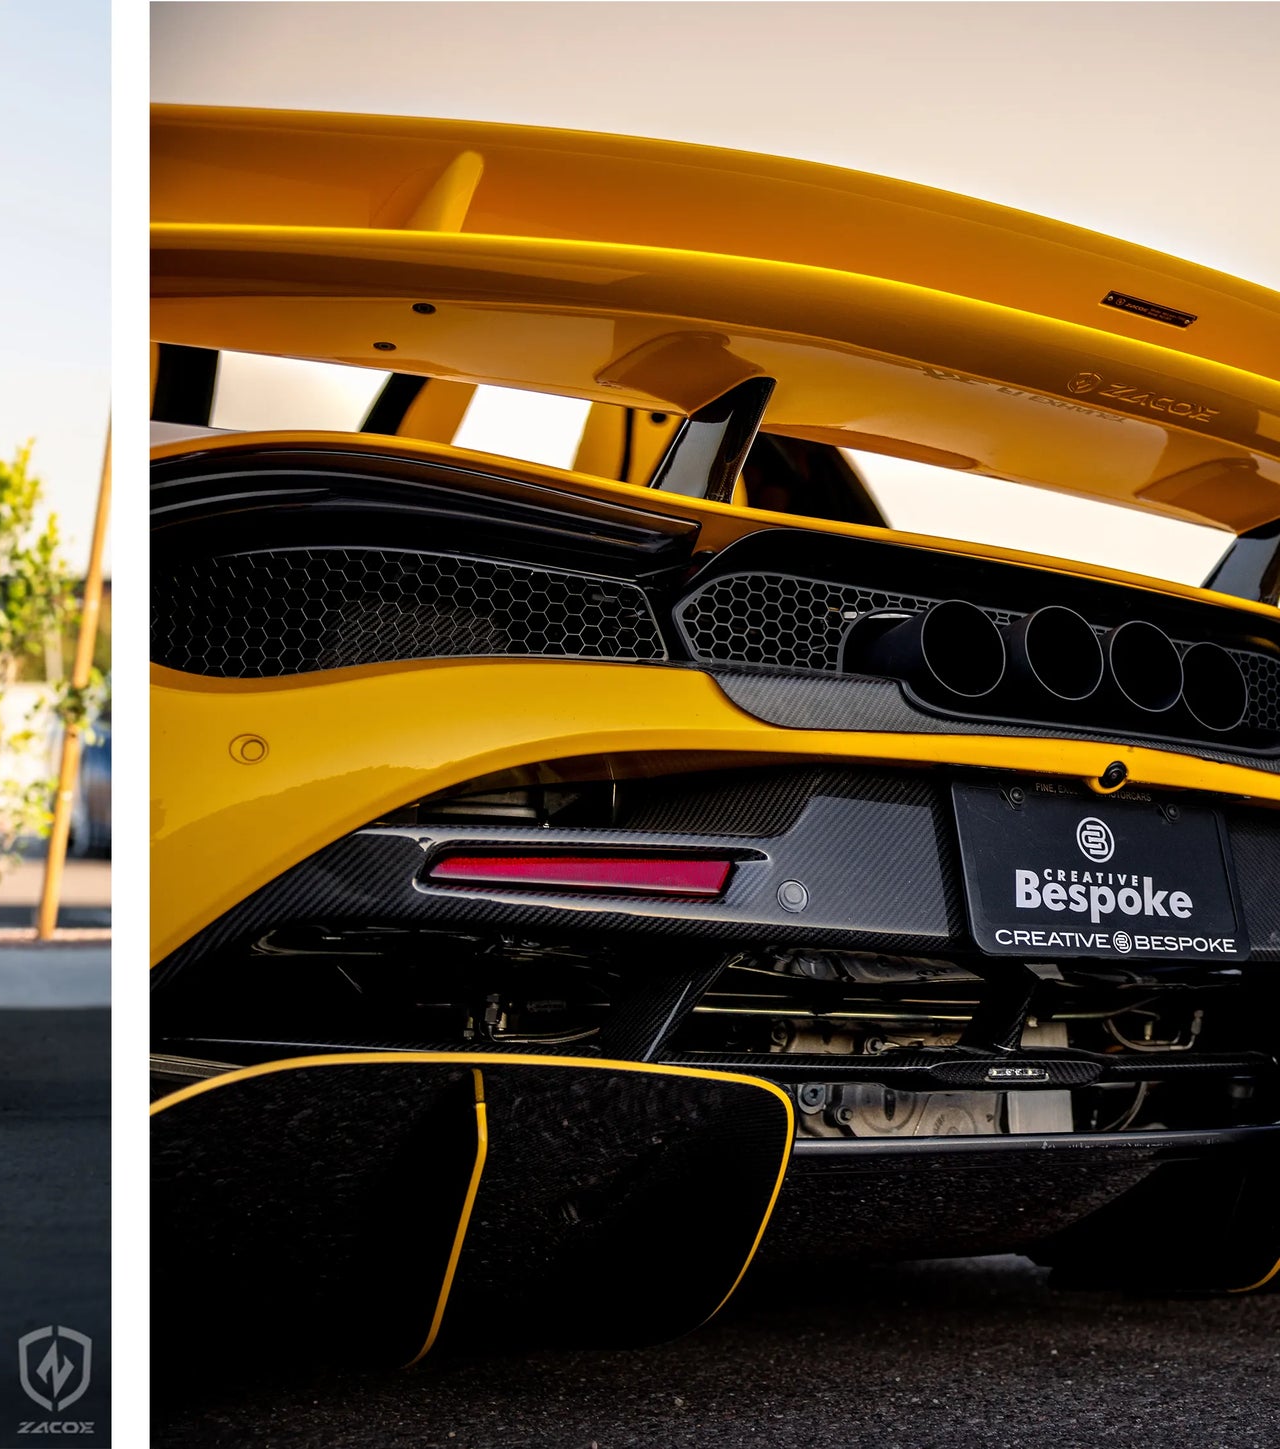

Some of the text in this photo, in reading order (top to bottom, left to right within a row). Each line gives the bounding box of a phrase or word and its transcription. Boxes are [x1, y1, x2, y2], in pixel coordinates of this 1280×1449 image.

[1099, 383, 1220, 423] ZACOE
[1043, 868, 1138, 887] CREATIVE
[1015, 869, 1193, 924] Bespoke
[995, 929, 1110, 949] CREATIVE
[1134, 935, 1237, 953] BESPOKE
